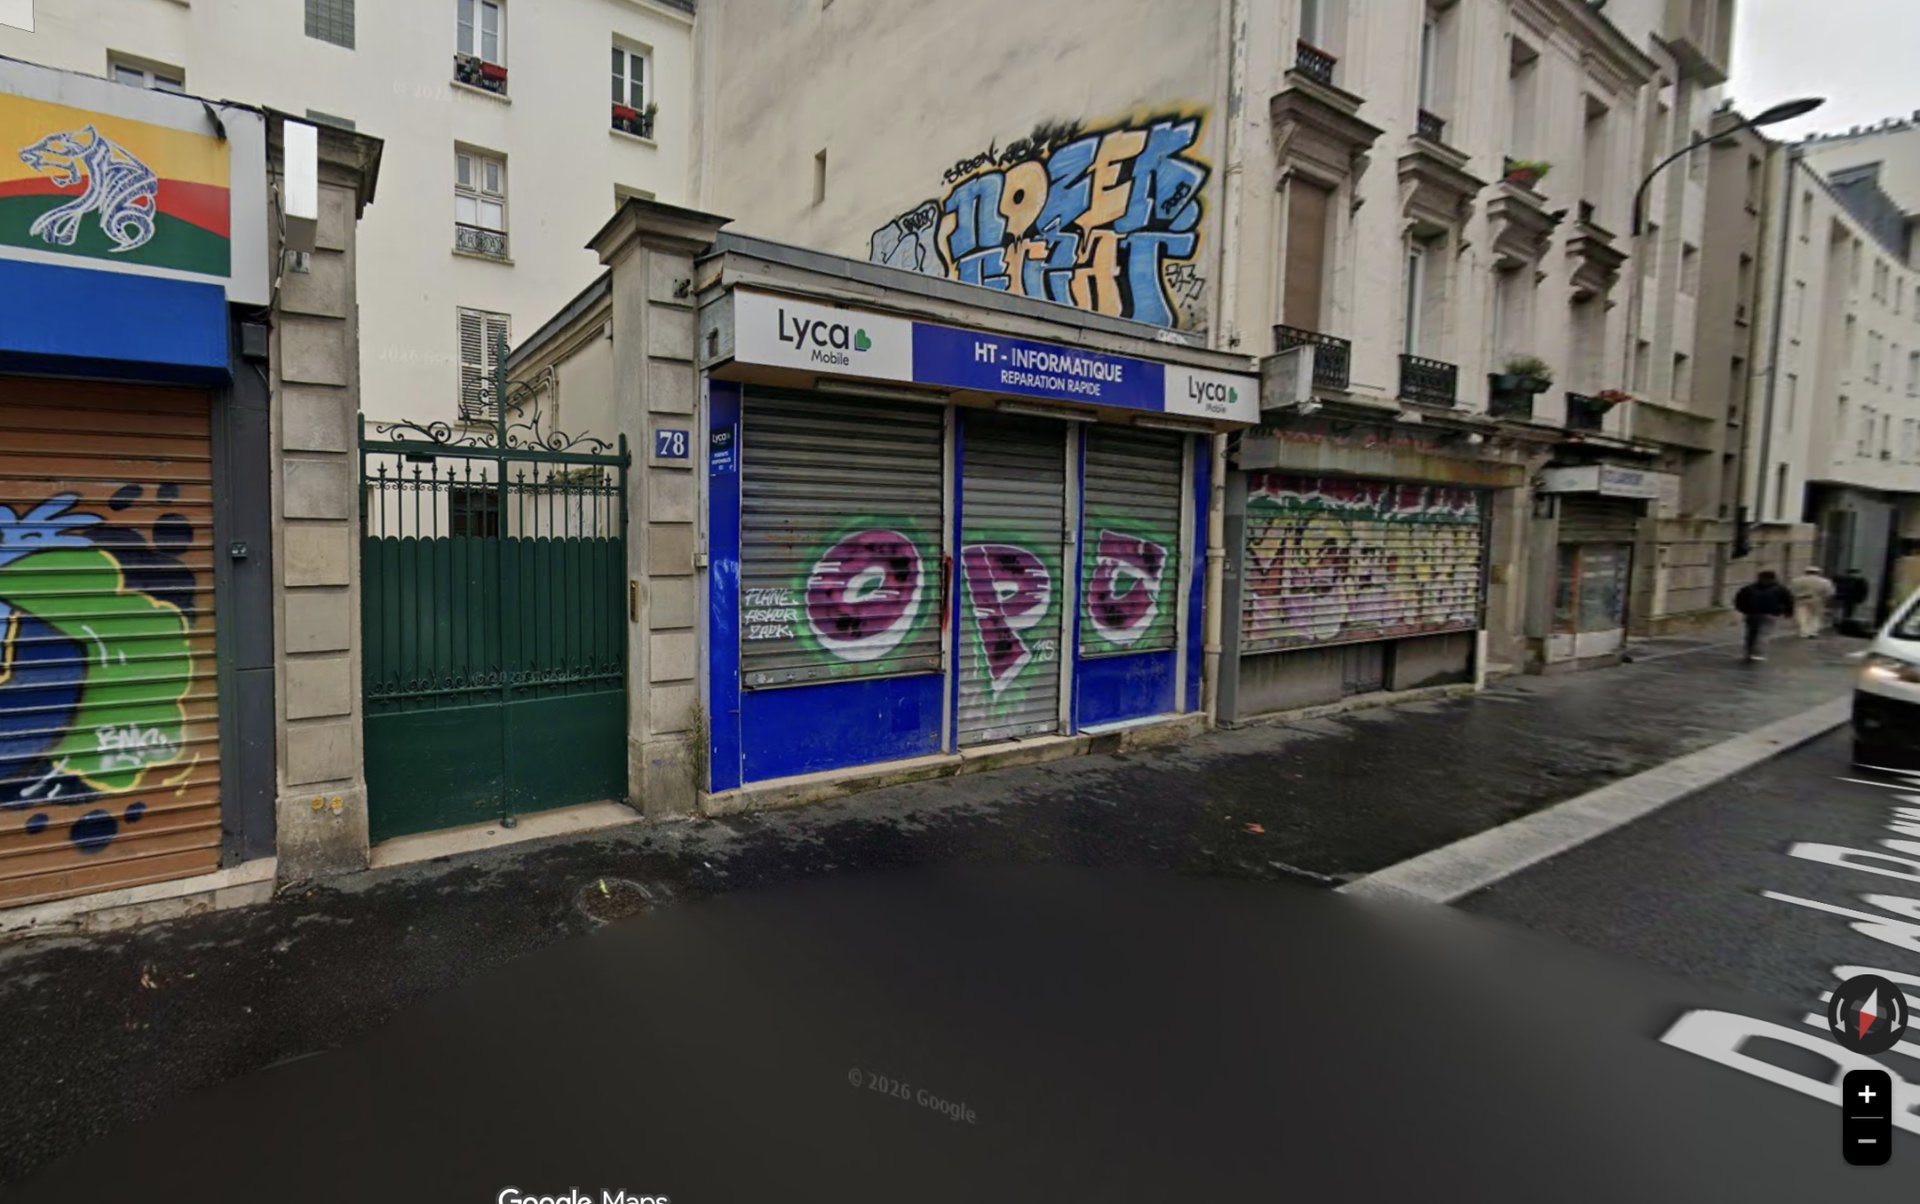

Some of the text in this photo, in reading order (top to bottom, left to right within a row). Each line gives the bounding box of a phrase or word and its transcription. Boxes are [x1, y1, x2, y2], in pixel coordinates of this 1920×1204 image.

[779, 309, 849, 350] Lyca
[811, 349, 849, 366] Mobile
[975, 342, 997, 363] HT
[1012, 348, 1123, 382] INFORMATIQUE
[1001, 370, 1101, 396] REPARATION RAPIDE
[1188, 375, 1227, 404] Lyca
[660, 431, 684, 456] 78
